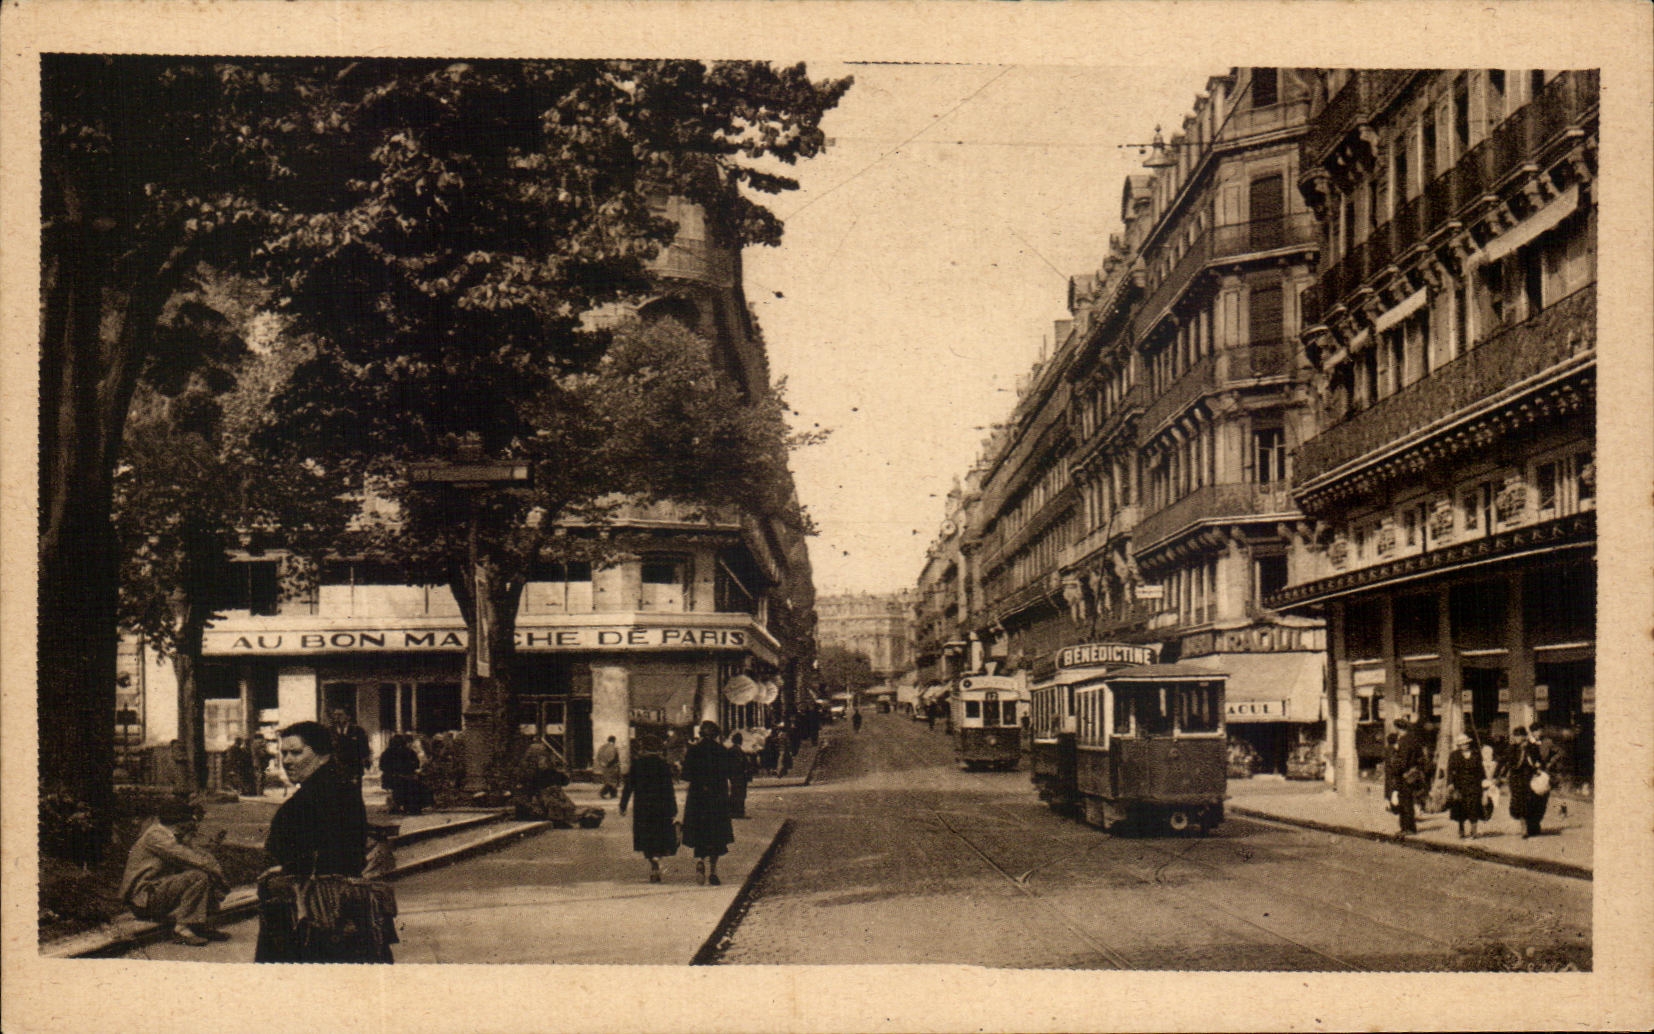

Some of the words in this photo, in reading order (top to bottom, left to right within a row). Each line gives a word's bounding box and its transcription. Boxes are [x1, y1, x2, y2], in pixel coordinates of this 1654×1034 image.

[232, 634, 282, 650] AU
[301, 633, 386, 649] BON
[597, 630, 649, 646] DE
[661, 629, 746, 646] PARIS
